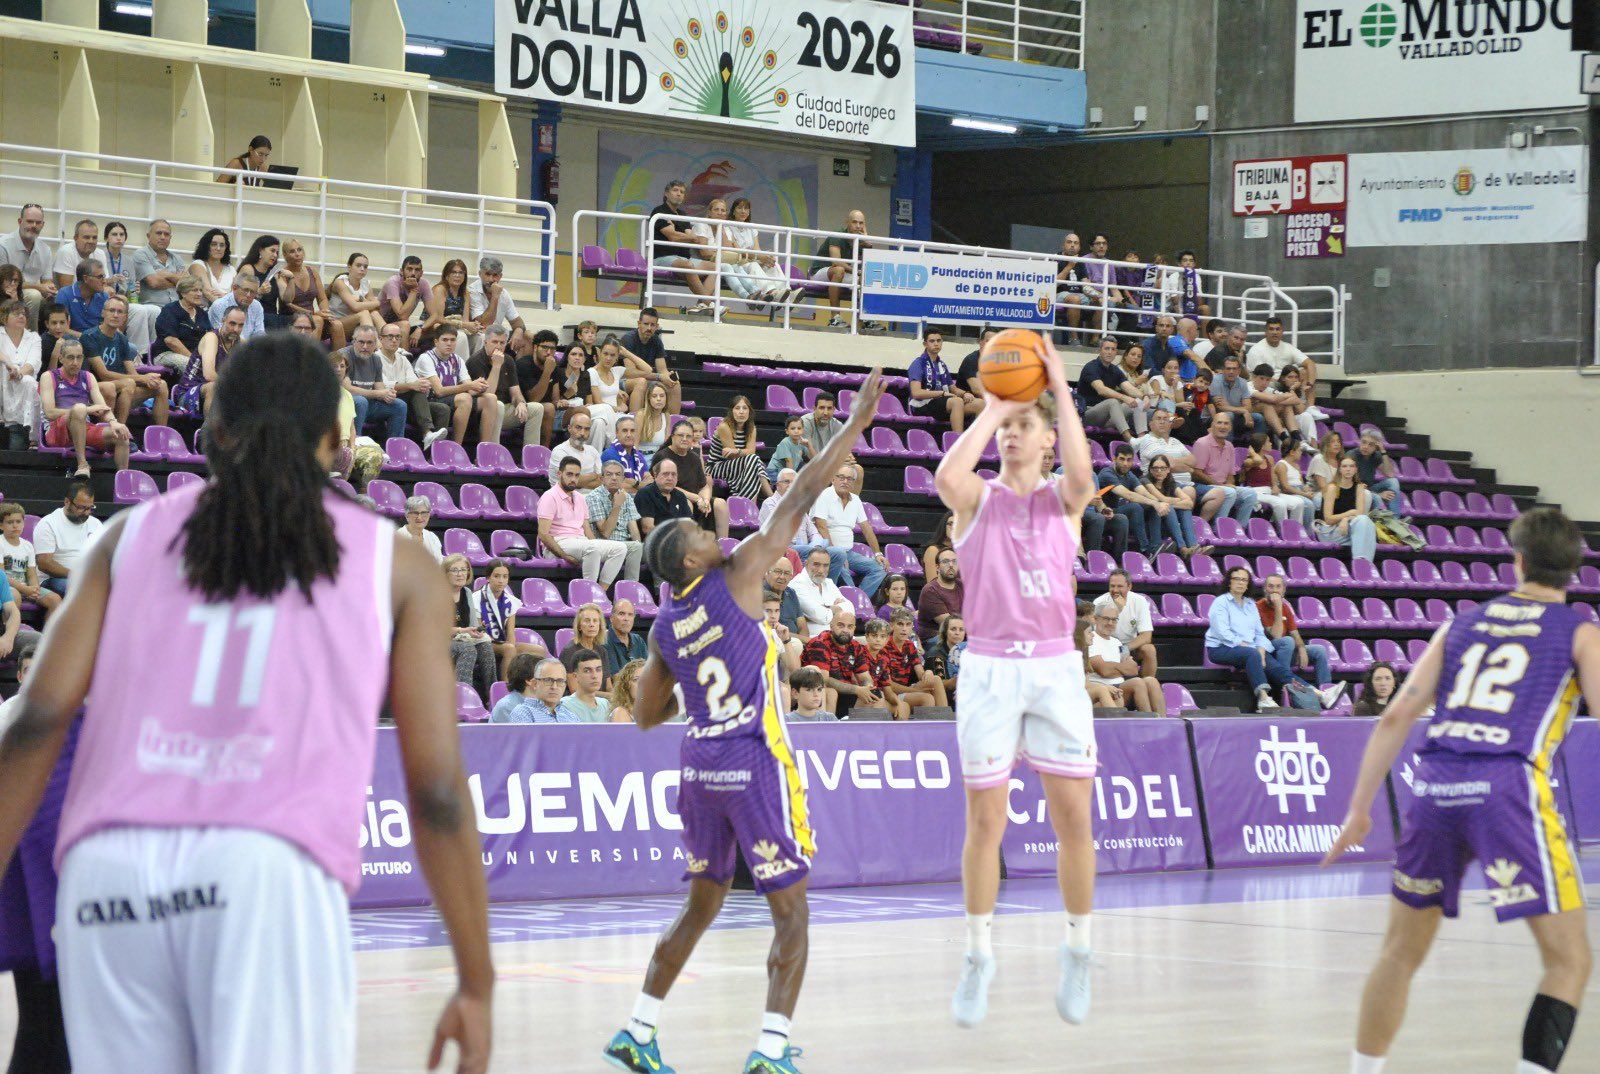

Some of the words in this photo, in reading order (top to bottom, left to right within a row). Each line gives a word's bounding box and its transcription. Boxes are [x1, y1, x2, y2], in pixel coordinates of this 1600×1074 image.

[1303, 9, 1352, 49] EL
[796, 11, 901, 79] 2026
[1398, 37, 1523, 60] VALLADOLID
[510, 33, 648, 105] DOLID
[796, 92, 843, 114] Ciudad
[845, 99, 896, 121] Europea
[795, 111, 816, 129] del
[818, 114, 870, 136] Deporte
[1237, 166, 1290, 187] TRIBUNA
[1292, 168, 1308, 200] B
[1359, 176, 1447, 193] Ayuntamiento
[1485, 173, 1502, 187] de
[1506, 168, 1577, 186] Valladolid
[1245, 189, 1280, 201] BAJA
[1287, 212, 1332, 230] ACCESO
[1398, 208, 1443, 223] FMD
[1286, 227, 1323, 243] PALCO
[1286, 241, 1320, 257] PISTA
[863, 261, 929, 291] FMD
[931, 266, 993, 281] Fundación
[996, 270, 1056, 284] Municipal
[955, 283, 970, 294] de
[973, 284, 1034, 297] Deportes
[932, 304, 984, 317] AYUNTAMIENTO
[985, 307, 995, 317] DE
[996, 308, 1034, 319] VALLADOLID
[188, 604, 276, 708] 11
[697, 655, 742, 721] 2
[1446, 643, 1530, 714] 12
[795, 750, 951, 790] IVECO
[1104, 834, 1184, 850] CONSTRUCCIÓN
[1243, 824, 1365, 854] CARRAMIMB
[362, 861, 412, 875] FUTURO
[482, 847, 685, 867] UNIVERSIDA
